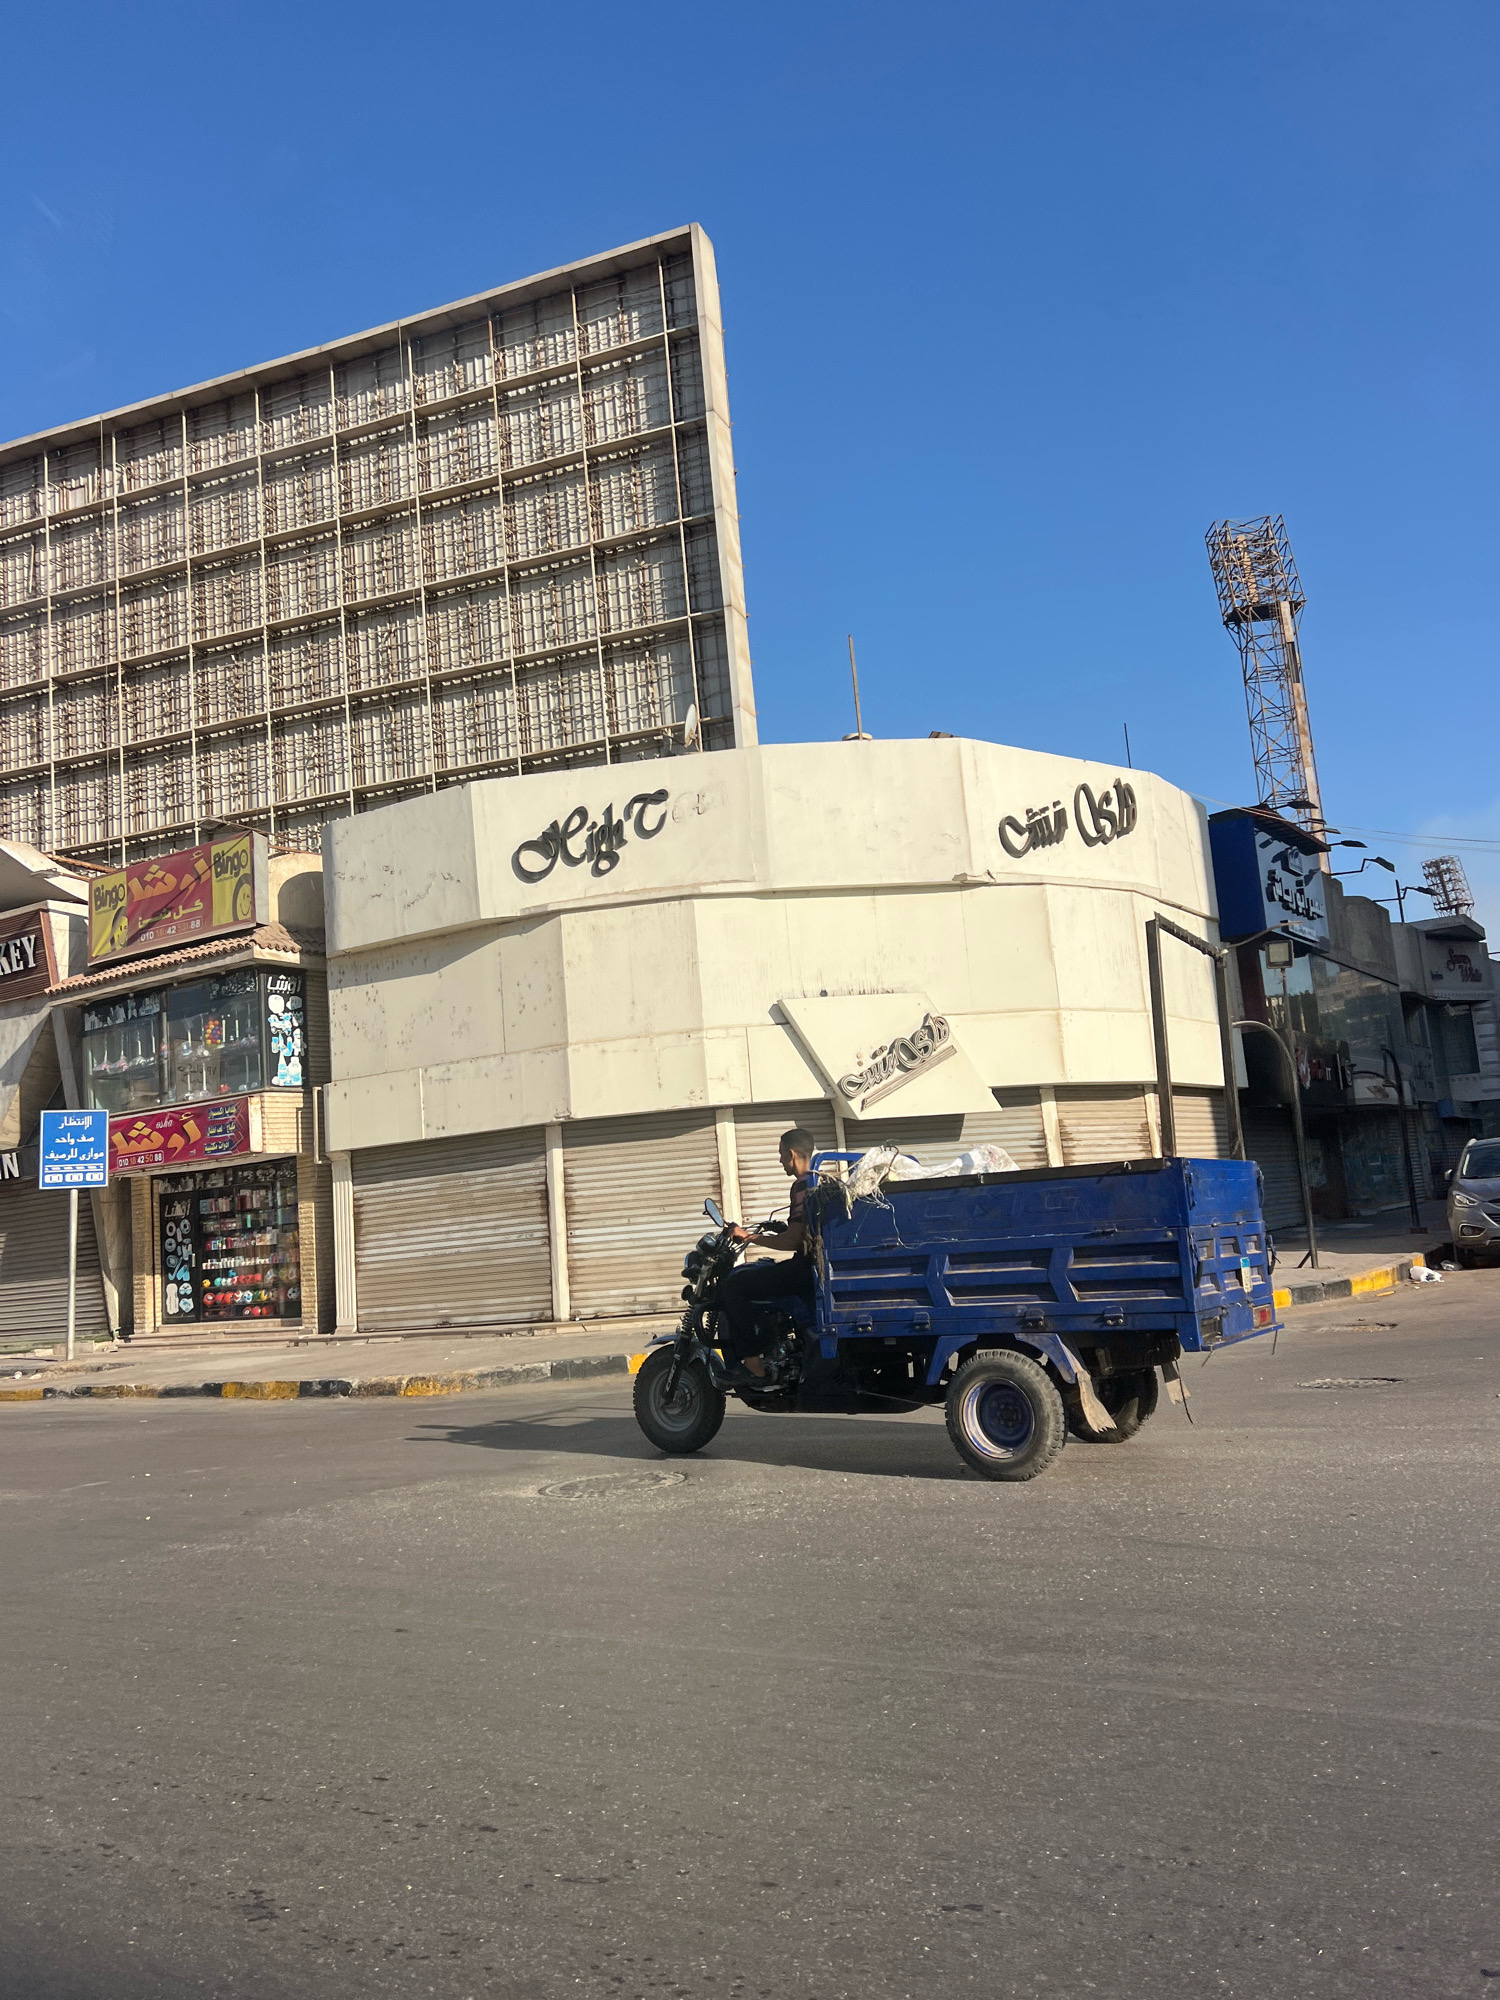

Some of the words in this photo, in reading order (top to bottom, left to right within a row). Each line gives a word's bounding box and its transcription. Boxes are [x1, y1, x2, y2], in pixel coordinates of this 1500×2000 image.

[511, 802, 628, 884] High
[213, 849, 249, 878] Bingo
[127, 850, 212, 902] أوشا
[94, 883, 126, 911] Bingo
[173, 899, 203, 920] كل
[166, 925, 177, 935] 42
[155, 1112, 174, 1129] osha
[54, 1132, 76, 1145] واحد
[76, 1134, 95, 1143] صف
[111, 1111, 202, 1159] أوشا
[44, 1147, 78, 1161] للرصيف
[118, 1158, 129, 1168] 010
[137, 1155, 145, 1164] 42
